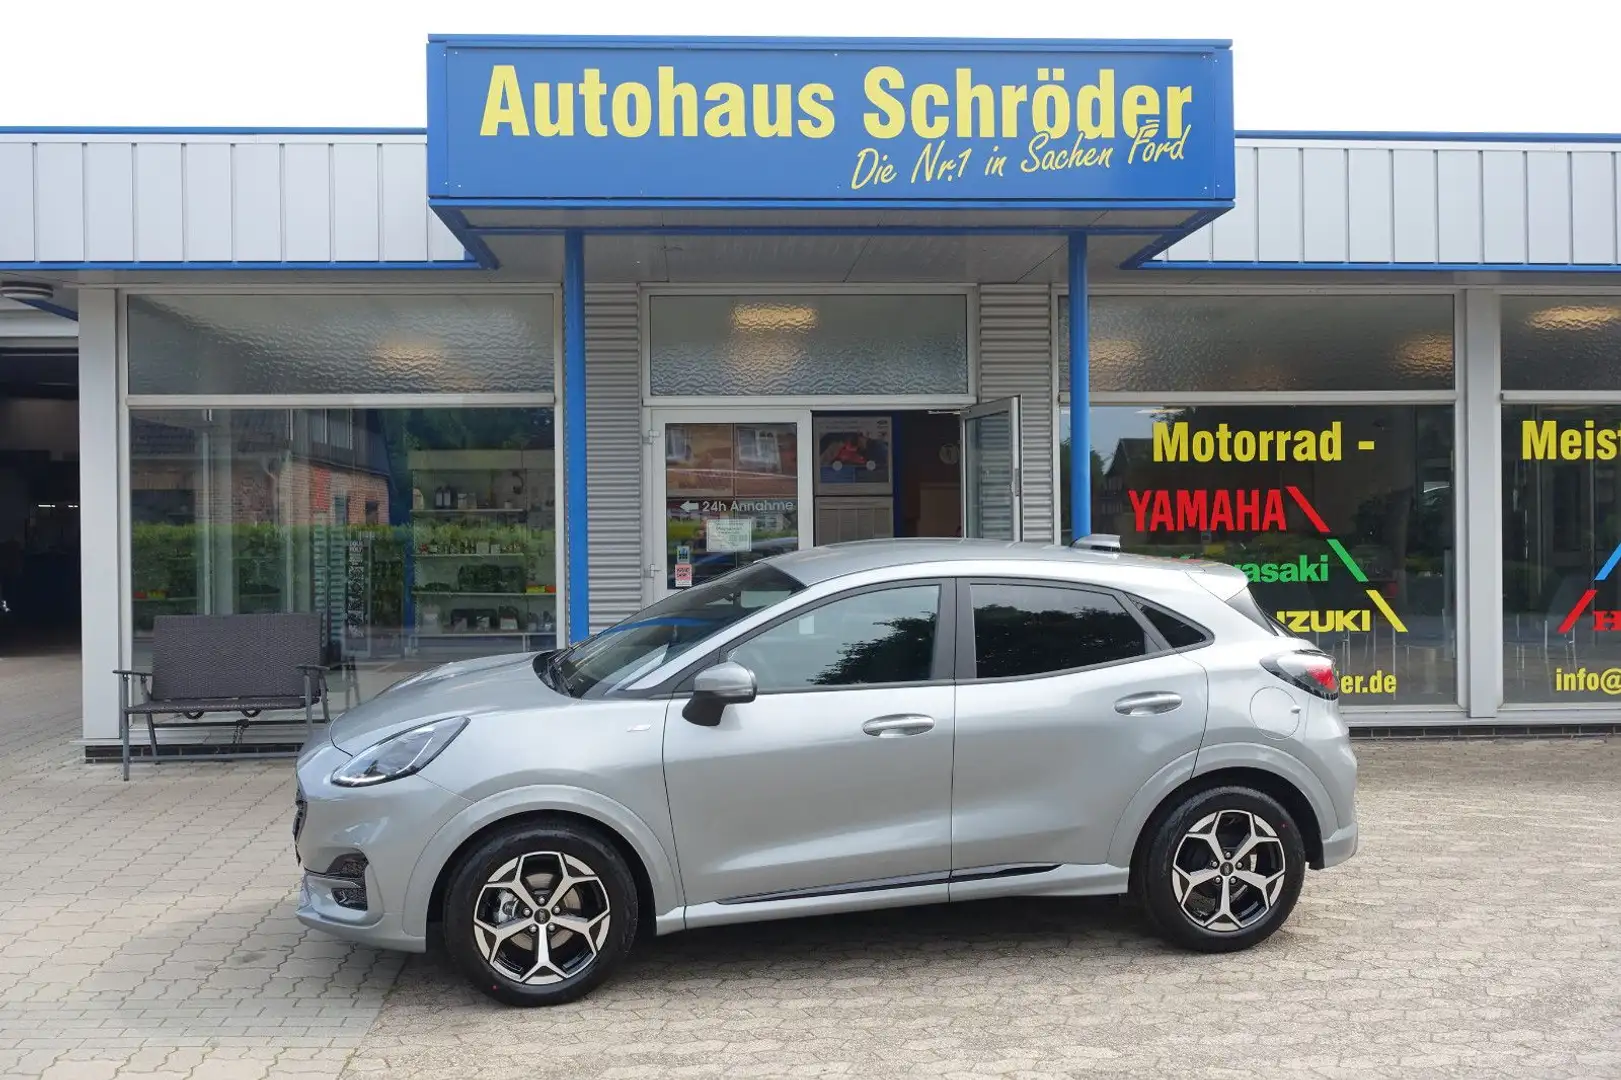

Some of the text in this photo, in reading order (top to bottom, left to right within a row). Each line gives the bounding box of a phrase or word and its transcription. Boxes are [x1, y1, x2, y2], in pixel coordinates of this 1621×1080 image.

[480, 64, 1192, 139] Autohaus Schröder
[851, 119, 1191, 190] Die Nr.1 in Sachen Ford
[1152, 421, 1343, 463] Motorrad
[1522, 420, 1621, 461] Meis
[702, 500, 796, 512] 24h Annahme
[1128, 489, 1288, 532] YAMAHA
[1232, 554, 1330, 583] asaki
[1276, 609, 1371, 633] ZUKI
